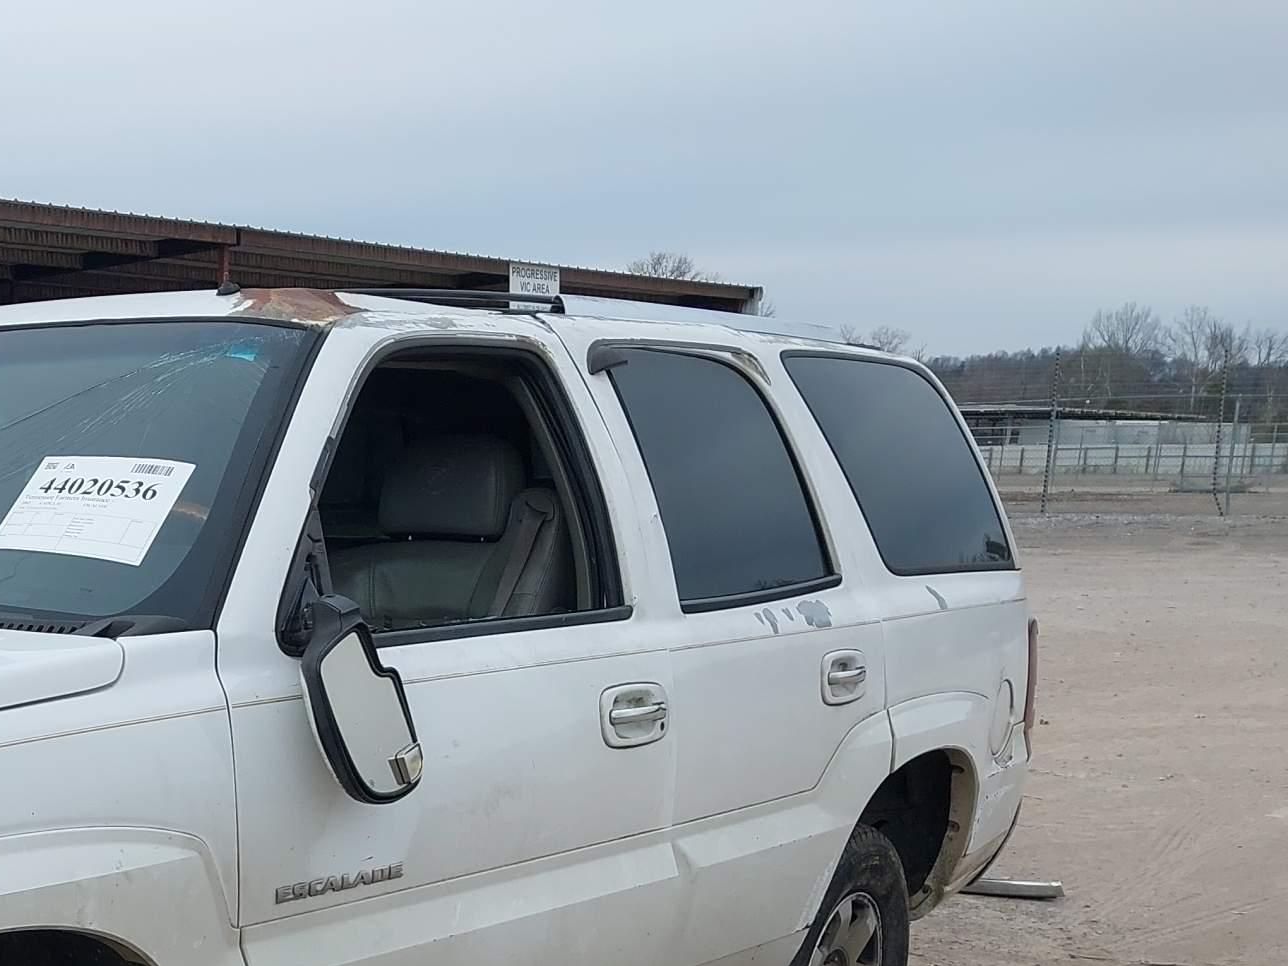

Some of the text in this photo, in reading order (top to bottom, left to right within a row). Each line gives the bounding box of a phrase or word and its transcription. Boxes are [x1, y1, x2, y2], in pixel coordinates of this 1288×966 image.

[512, 266, 558, 282] PROGRESSIVE
[520, 281, 550, 295] VIC AREA
[39, 477, 162, 501] 44020536
[275, 862, 404, 905] ESCALADE
